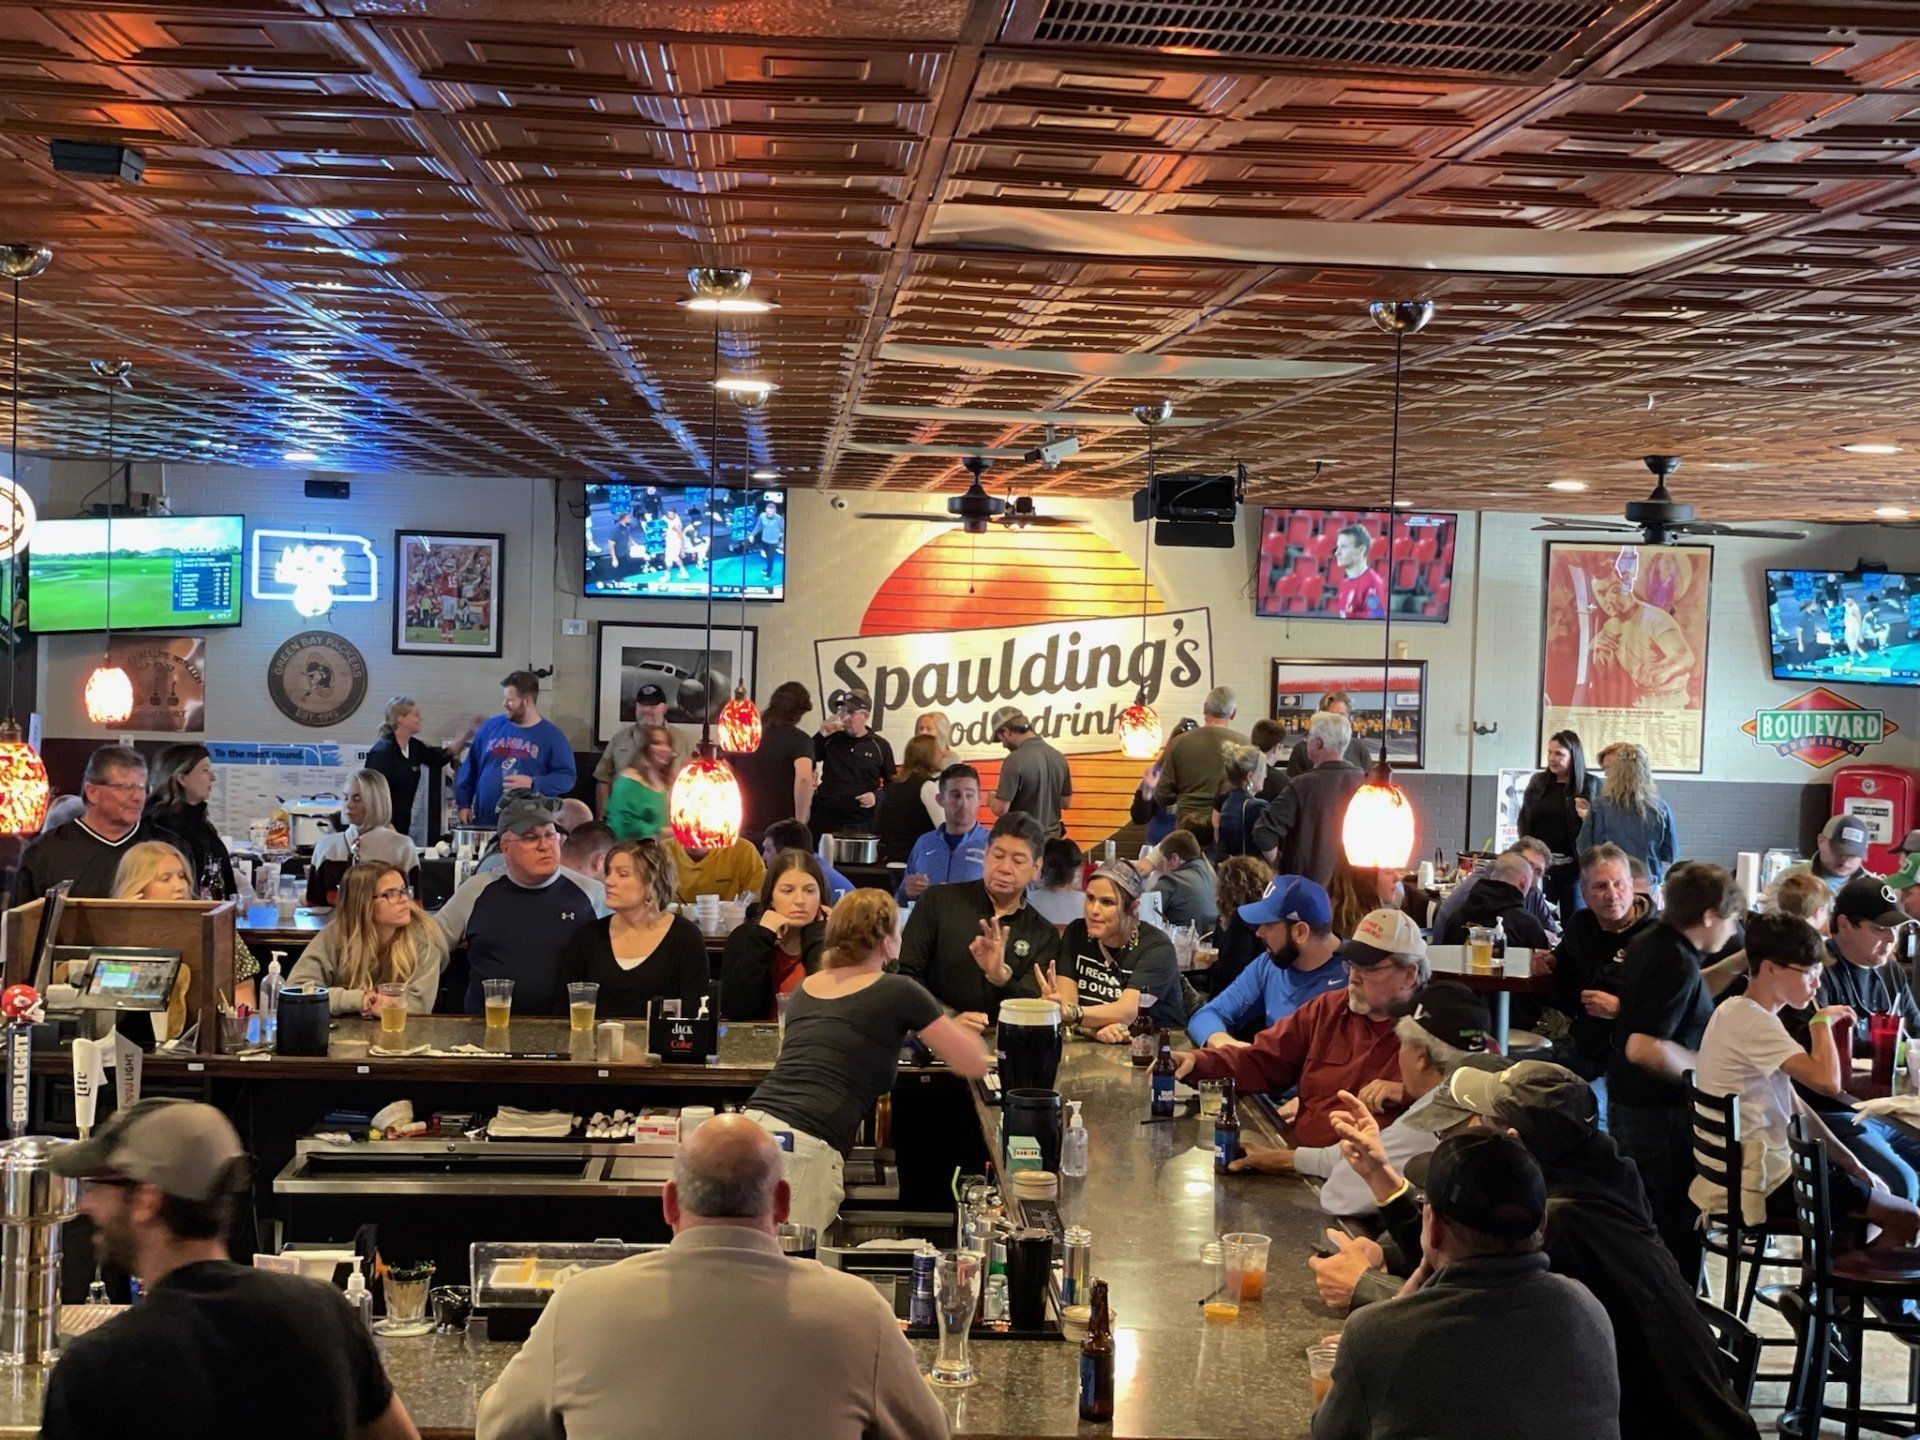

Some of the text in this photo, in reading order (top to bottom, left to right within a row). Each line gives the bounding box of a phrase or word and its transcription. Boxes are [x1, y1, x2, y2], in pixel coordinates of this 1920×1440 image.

[275, 637, 362, 678] GREEN BAY PACKERS
[827, 618, 1202, 732] Spaulding's
[1031, 702, 1127, 738] drink
[1762, 714, 1880, 739] BOULEVARD
[214, 748, 304, 760] To the next round.
[486, 736, 539, 760] KANSAS
[1780, 737, 1843, 756] BREWING
[1078, 979, 1122, 998] BOURB
[671, 1023, 693, 1034] JACK
[671, 1039, 693, 1049] Coke
[12, 1034, 28, 1122] BUD LIGHT
[125, 1054, 134, 1081] LIGHT
